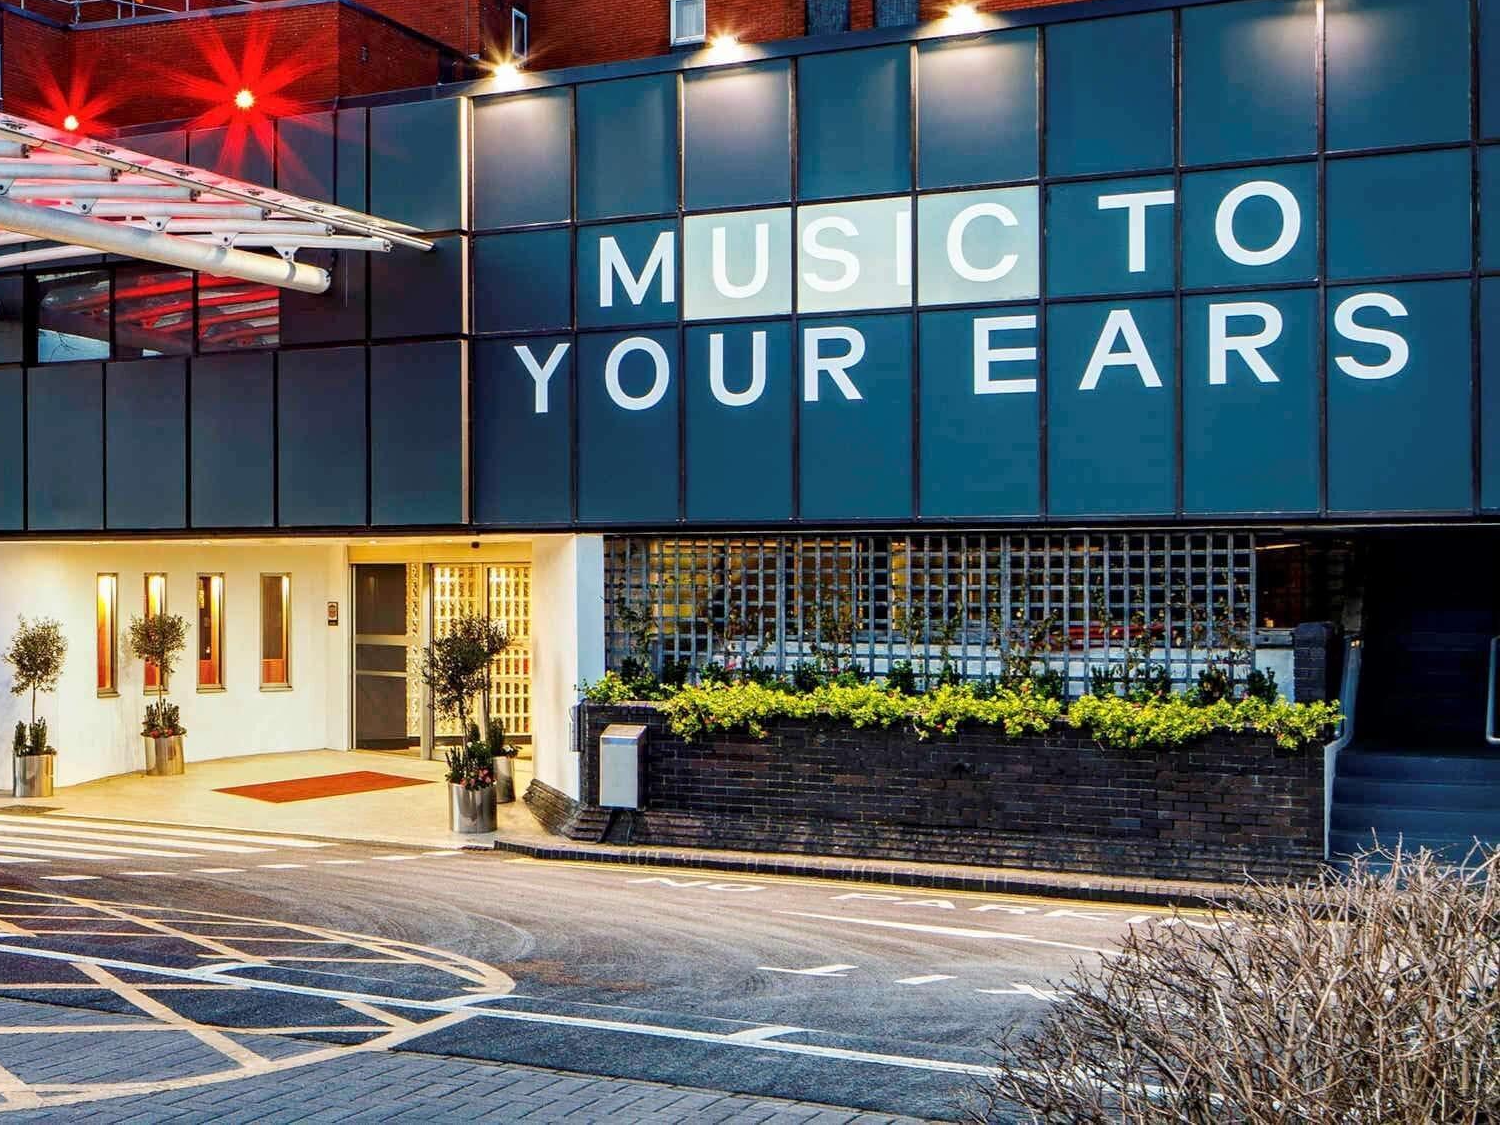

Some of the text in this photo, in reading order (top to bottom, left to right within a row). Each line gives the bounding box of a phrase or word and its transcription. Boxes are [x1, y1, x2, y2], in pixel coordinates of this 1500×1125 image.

[598, 180, 1303, 307] MUSIC TO
[512, 292, 1410, 413] YOUR EARS
[627, 877, 767, 893] NO
